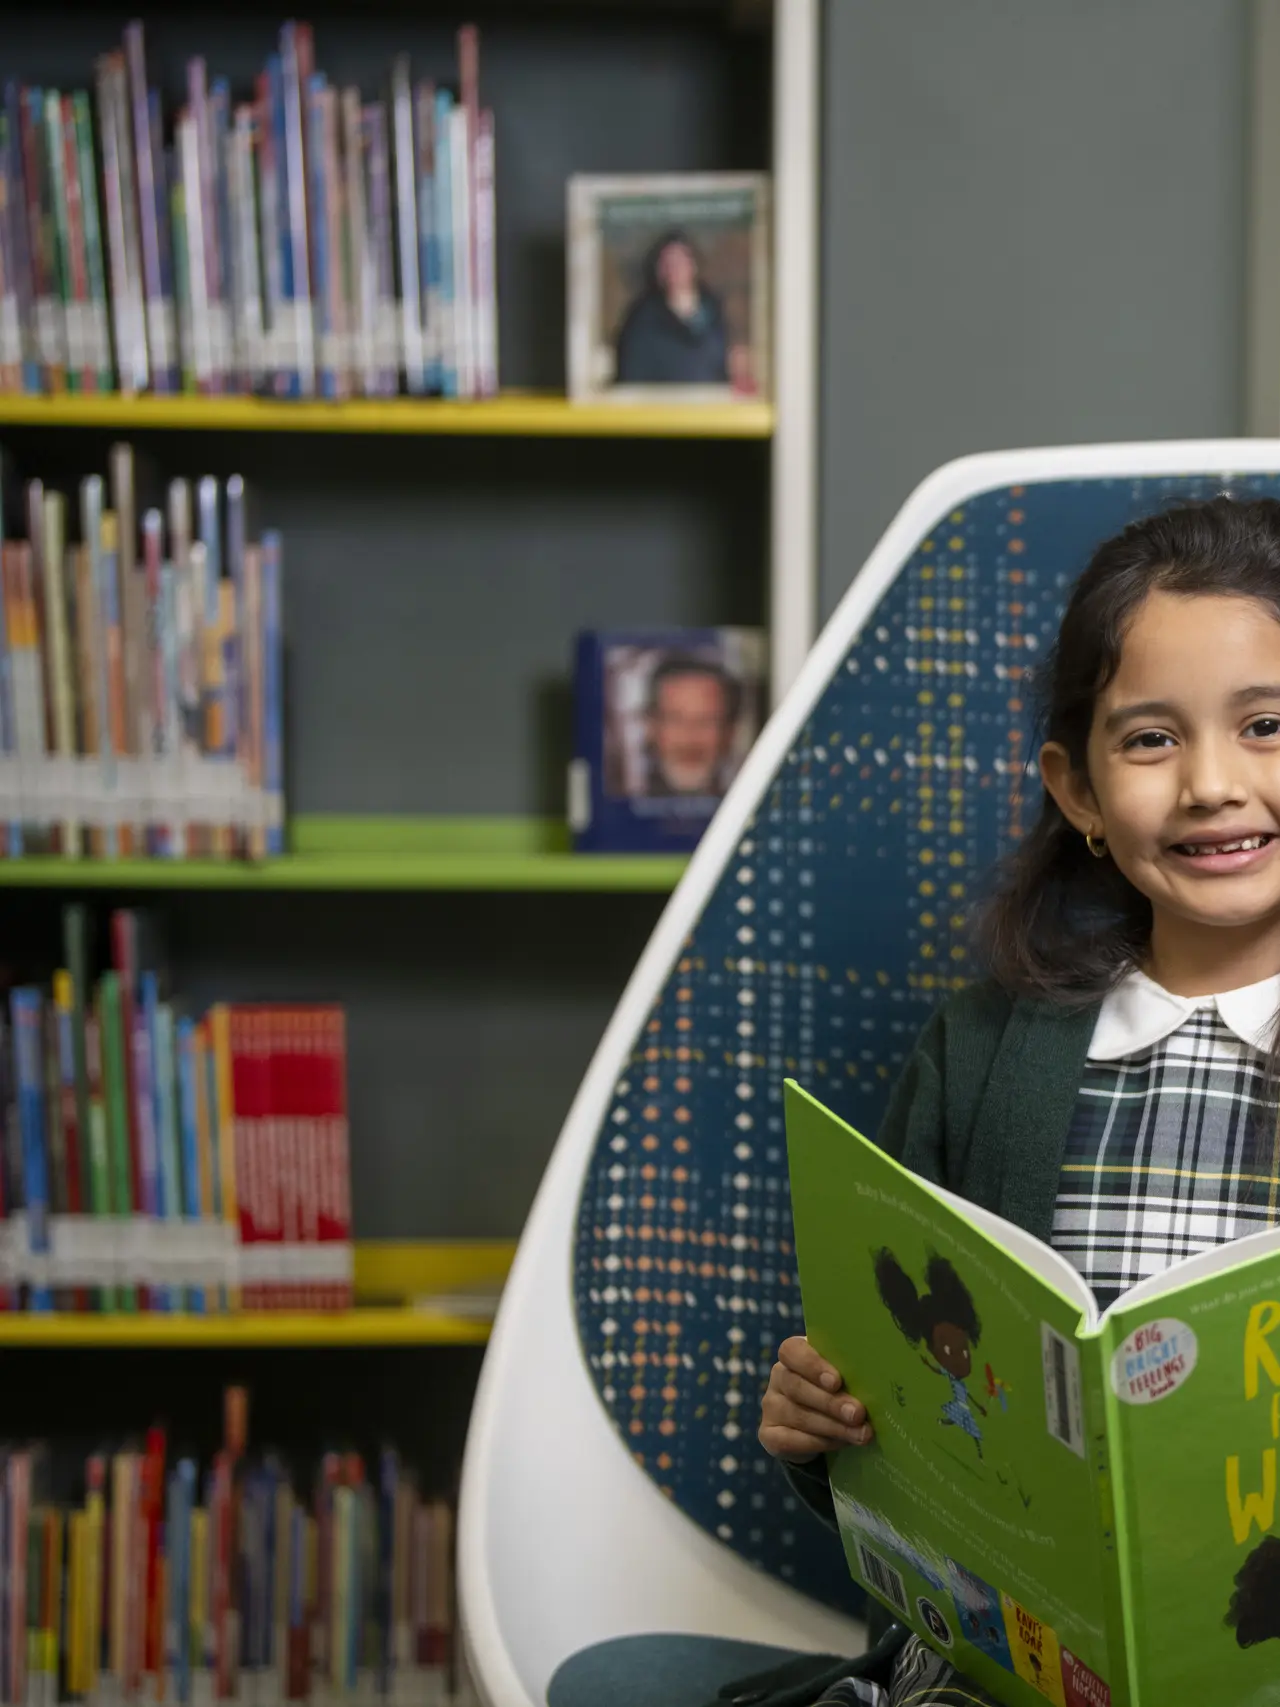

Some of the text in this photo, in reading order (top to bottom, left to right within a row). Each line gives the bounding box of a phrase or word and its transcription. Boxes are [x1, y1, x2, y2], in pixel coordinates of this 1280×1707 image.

[1126, 1334, 1178, 1378] BRIGHT
[1135, 1322, 1163, 1353] BIG
[1128, 1353, 1186, 1397] FEELINGS
